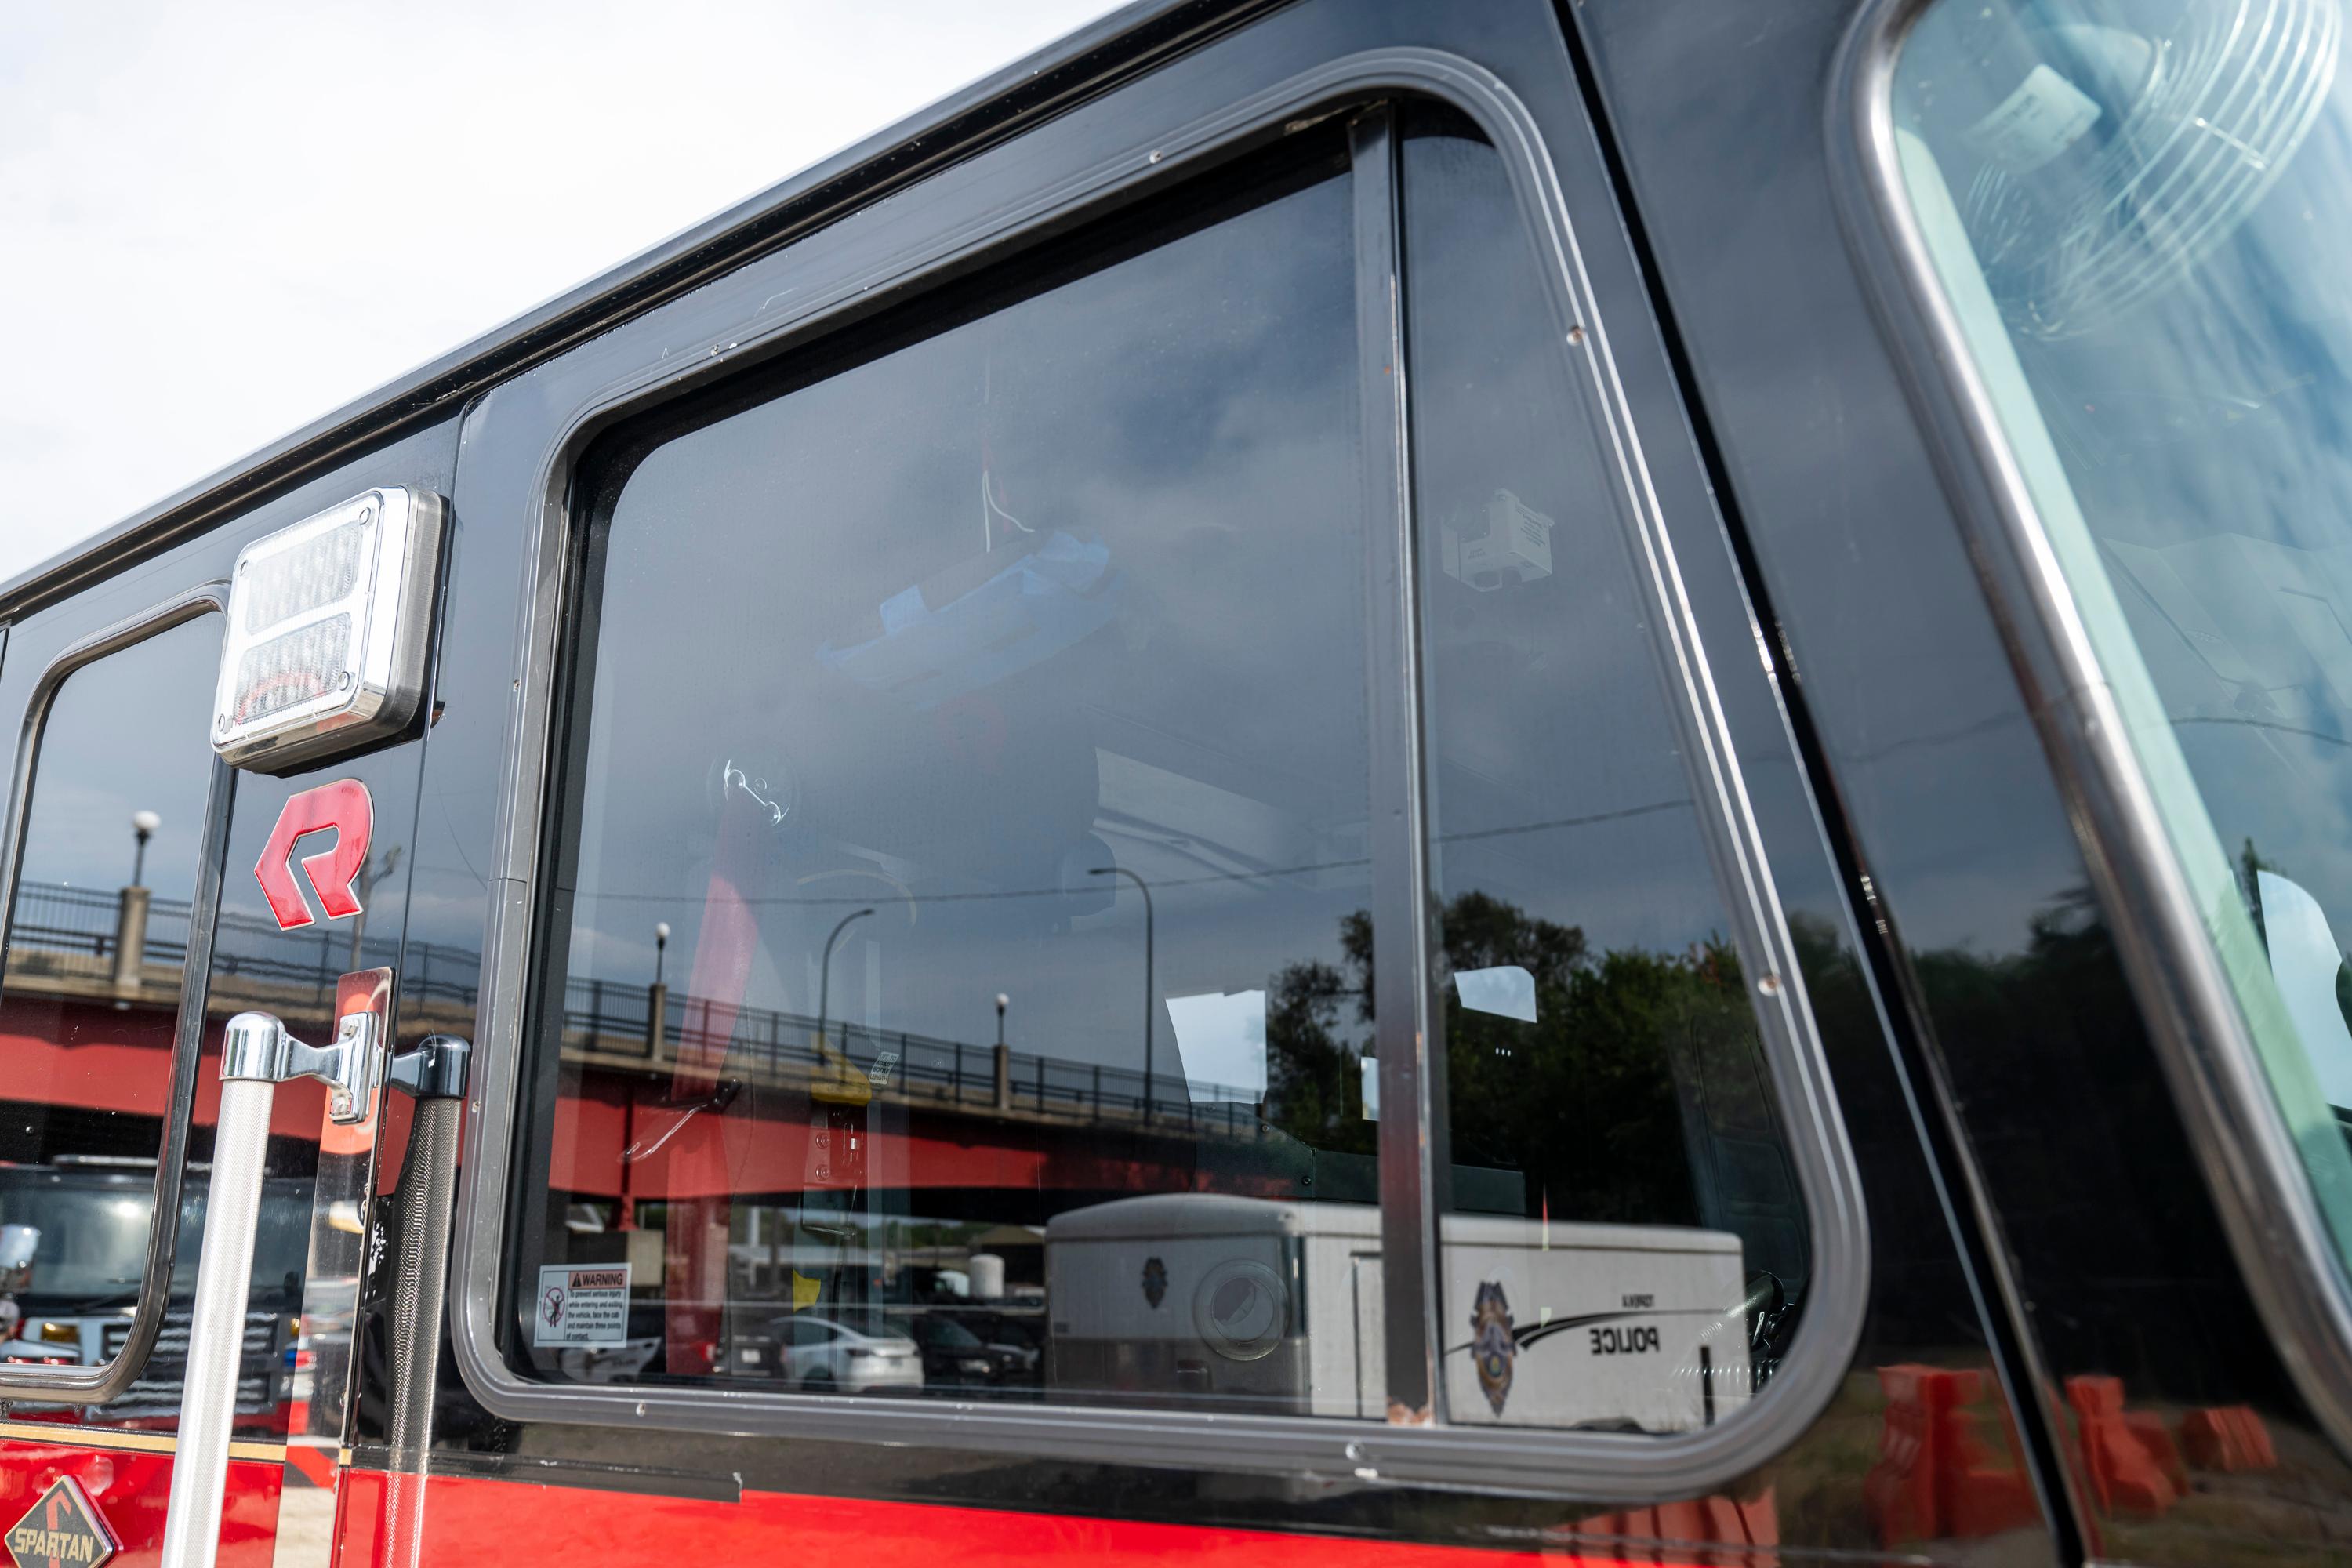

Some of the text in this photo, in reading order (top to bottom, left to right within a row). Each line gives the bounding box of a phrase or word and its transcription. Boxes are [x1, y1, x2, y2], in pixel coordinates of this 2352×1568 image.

[254, 778, 375, 931] R
[583, 1272, 622, 1285] WARNING
[13, 1528, 94, 1563] SPARTAN
